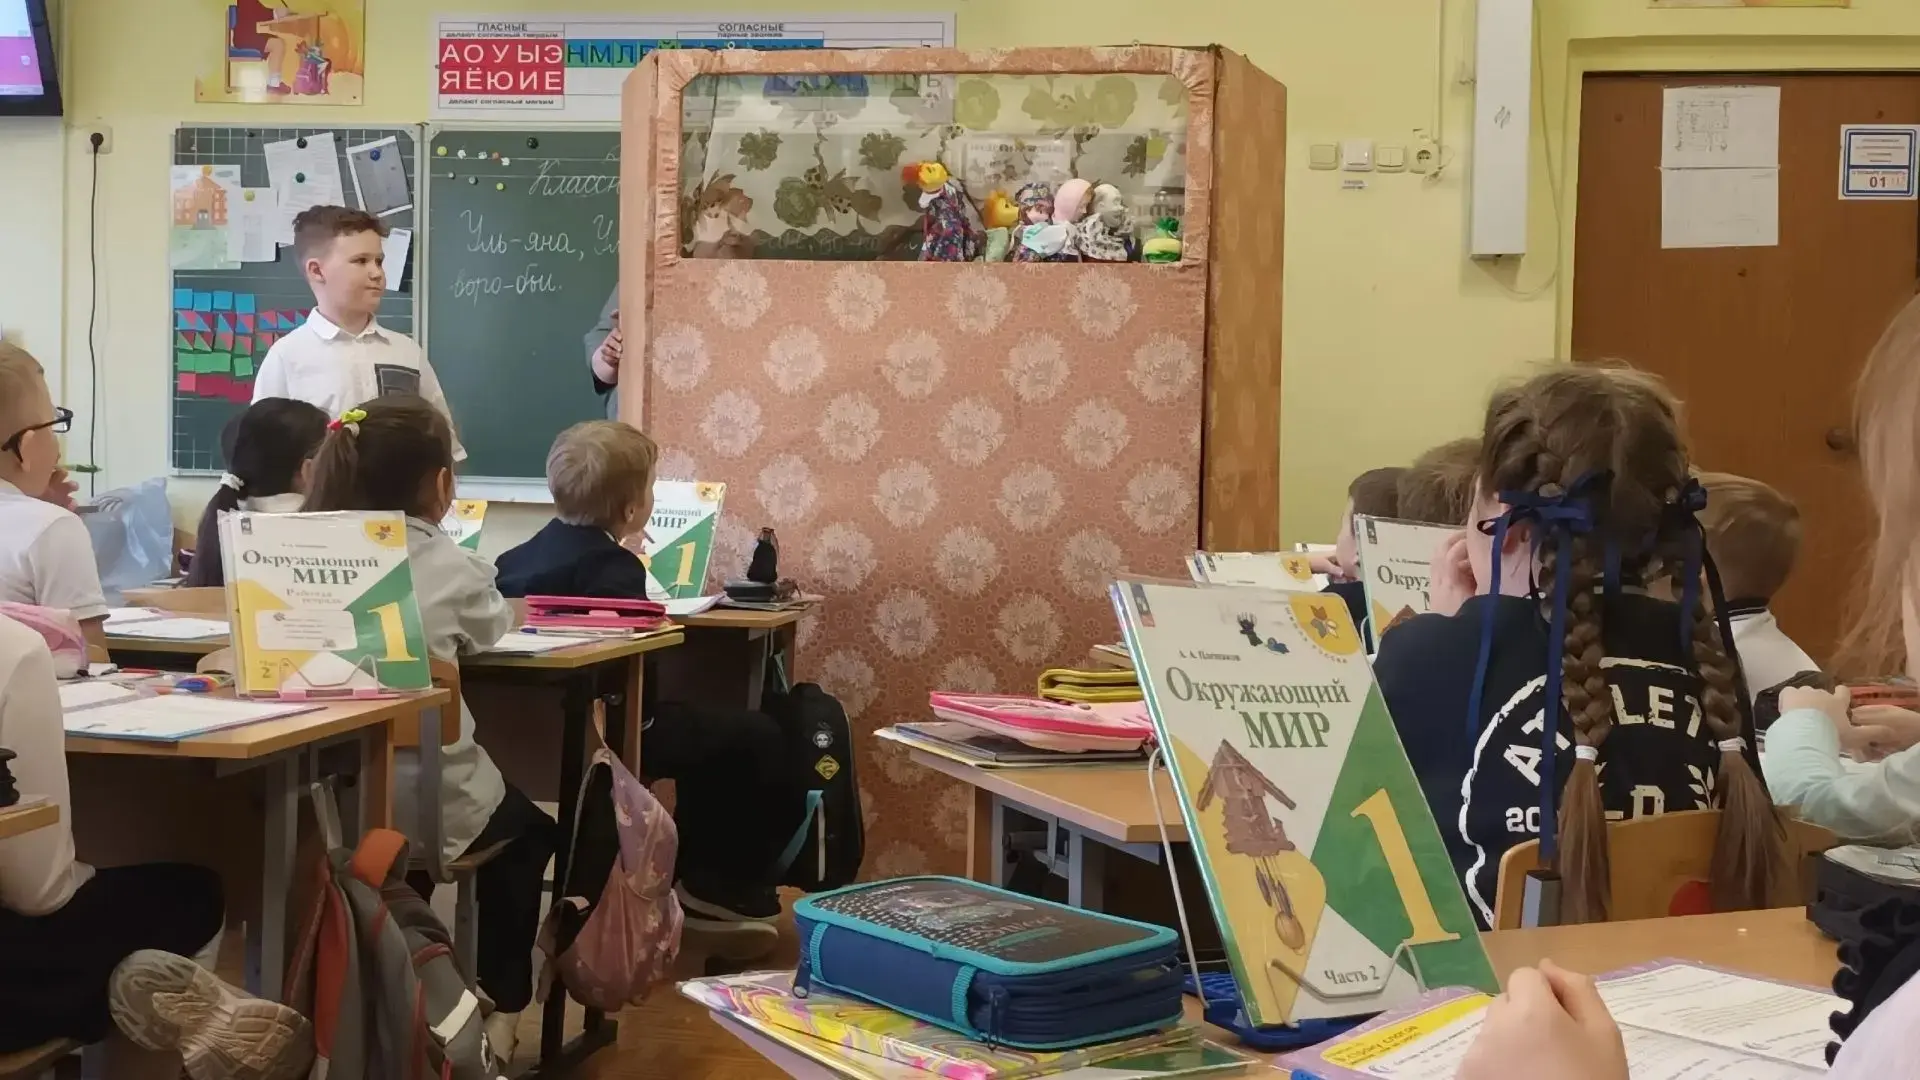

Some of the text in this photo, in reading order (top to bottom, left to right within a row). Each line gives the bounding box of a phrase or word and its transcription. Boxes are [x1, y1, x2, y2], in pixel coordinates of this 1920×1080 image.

[477, 23, 528, 32] ГЛАСНЫЕ
[718, 23, 784, 32] СОГЛАСНЫЕ
[242, 549, 379, 568] Окружающий
[676, 541, 696, 586] 1
[293, 567, 359, 585] МИР
[366, 601, 421, 662] 1
[261, 666, 271, 679] 2
[1166, 666, 1351, 710] Окружающий
[1238, 711, 1330, 749] МИР
[1350, 787, 1461, 946] 1
[1323, 965, 1380, 985] Часть 2
